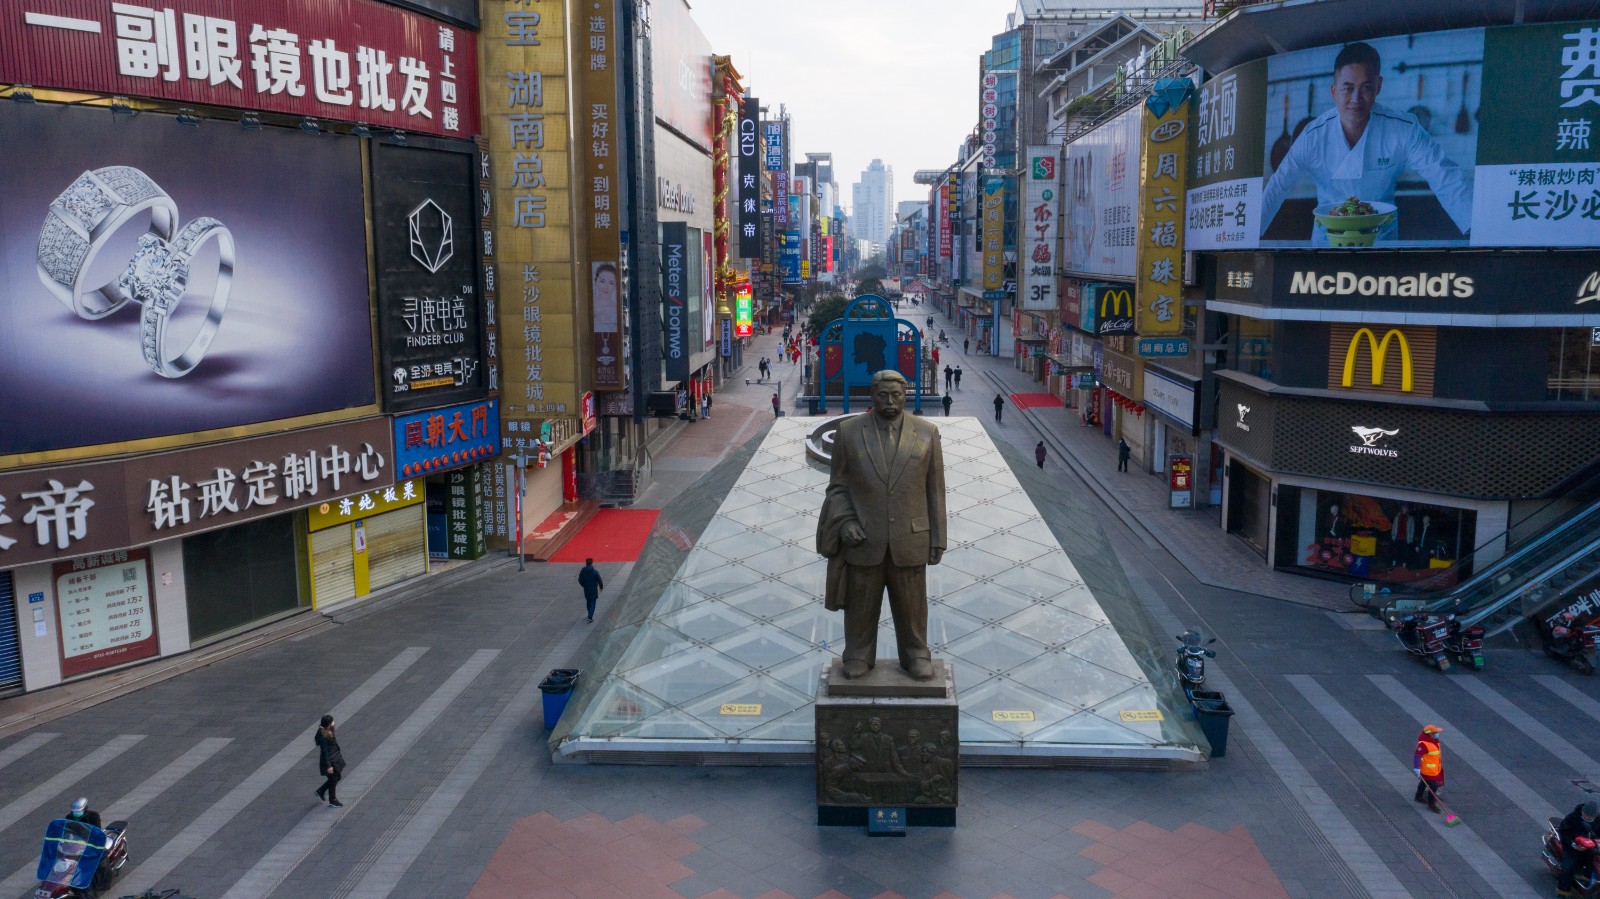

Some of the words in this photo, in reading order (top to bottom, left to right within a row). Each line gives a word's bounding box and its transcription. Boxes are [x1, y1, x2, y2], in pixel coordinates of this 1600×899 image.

[503, 0, 541, 46] 宝
[25, 2, 433, 119] 一副眼镜也批发
[438, 25, 459, 132] 请上四楼
[984, 75, 997, 167] 蝴蝶树婚纱艺术
[1198, 74, 1237, 147] 费大厨
[507, 70, 546, 228] 湖南总店
[741, 118, 755, 157] CRD
[767, 124, 781, 166] 旭升酒店
[1556, 118, 1592, 150] 辣
[743, 173, 757, 238] 克徕帝
[1190, 201, 1246, 230] 长沙必吃菜第一名
[1149, 152, 1178, 322] 周六福珠宝
[481, 153, 498, 391] 长沙眼镜批发城
[1290, 271, 1475, 299] McDonald's
[668, 244, 683, 359] Meters/bonwe
[1030, 284, 1051, 301] 3F
[402, 295, 467, 334] 寻鹿电竞
[521, 264, 544, 401] 长沙眼镜批发城
[407, 335, 441, 348] FINDEER
[443, 332, 465, 345] CLUB
[1141, 342, 1189, 353] 湖南总店
[508, 421, 532, 432] 眼镜
[527, 402, 567, 414] 请上四楼
[607, 401, 628, 415] 美发
[1349, 445, 1398, 458] SEPTWOLVES
[147, 442, 386, 531] 钻戒定制中心
[129, 619, 141, 627] 2万
[130, 630, 142, 639] 3万
